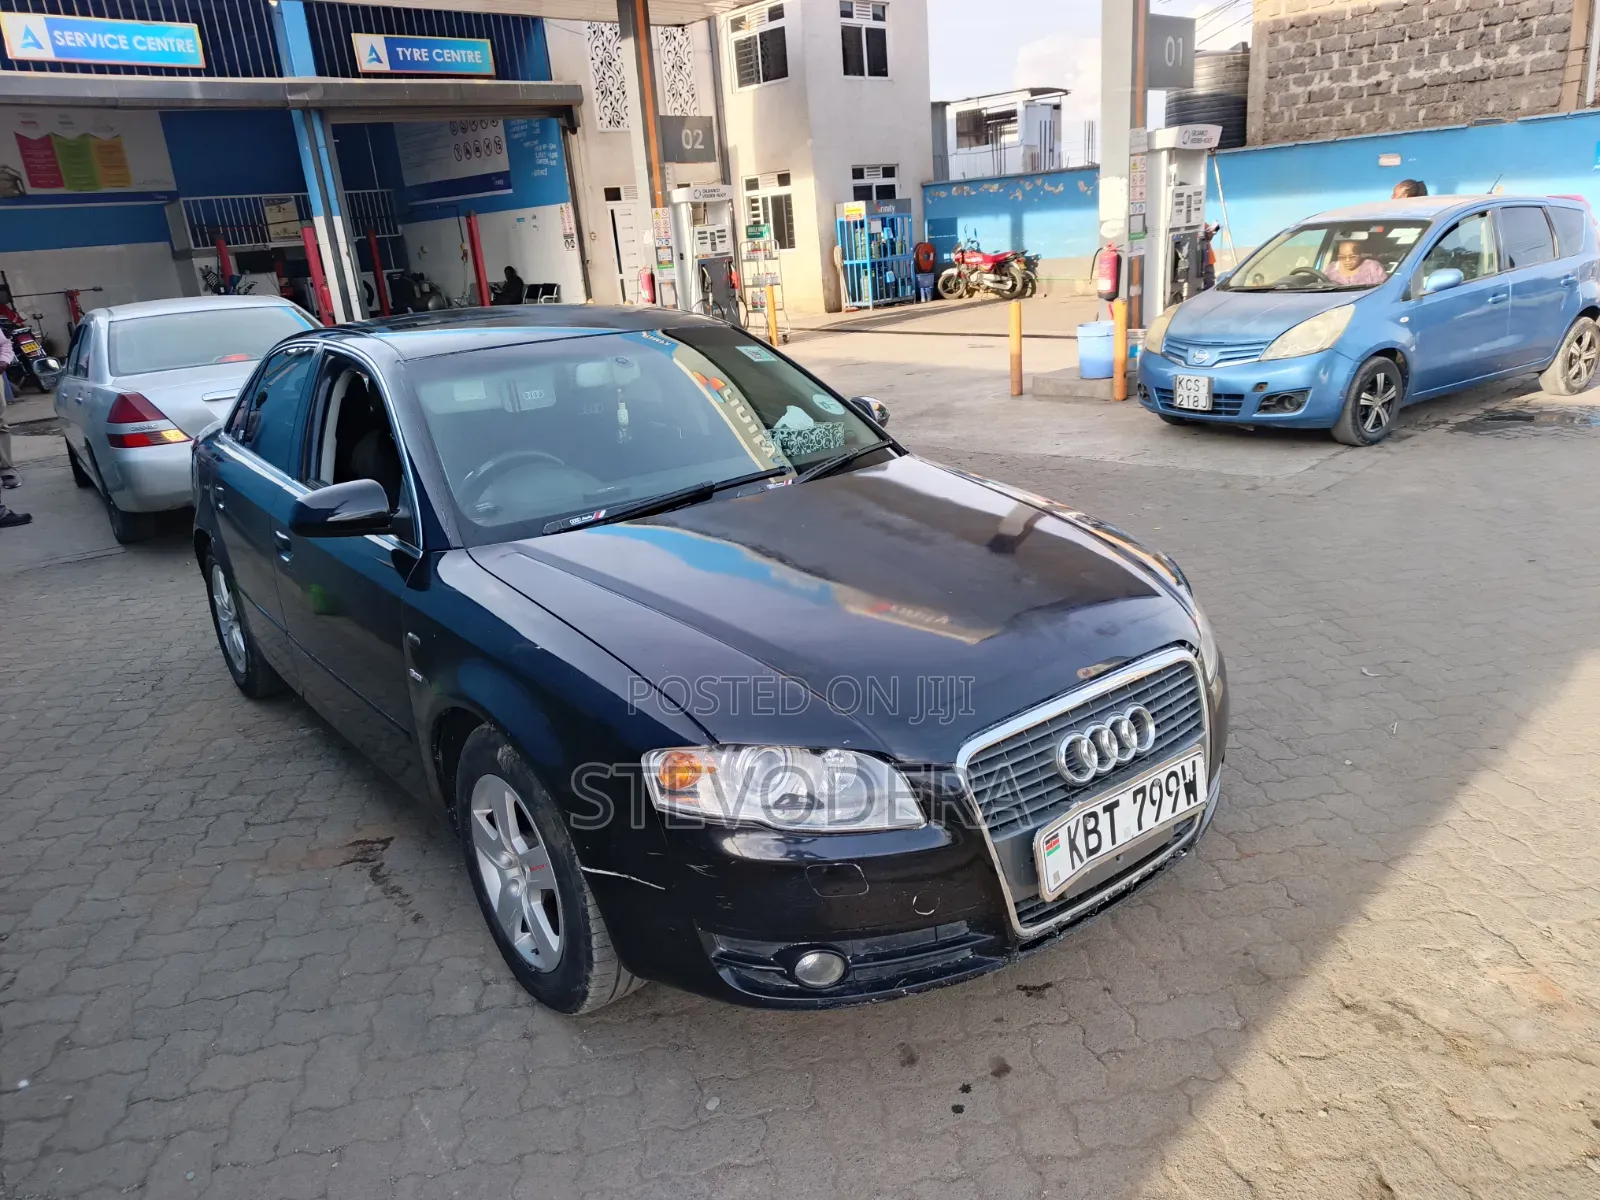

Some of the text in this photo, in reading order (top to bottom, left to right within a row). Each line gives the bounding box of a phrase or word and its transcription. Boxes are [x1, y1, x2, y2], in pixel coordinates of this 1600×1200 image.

[53, 30, 129, 50] SERVICE
[132, 35, 195, 53] CENTRE
[1165, 35, 1183, 67] 01
[396, 47, 429, 62] TYRE
[432, 50, 482, 64] CENTRE
[681, 128, 705, 150] 02
[1177, 377, 1200, 392] KCS
[1177, 393, 1209, 409] 218J
[1067, 760, 1198, 870] KBT 799W
